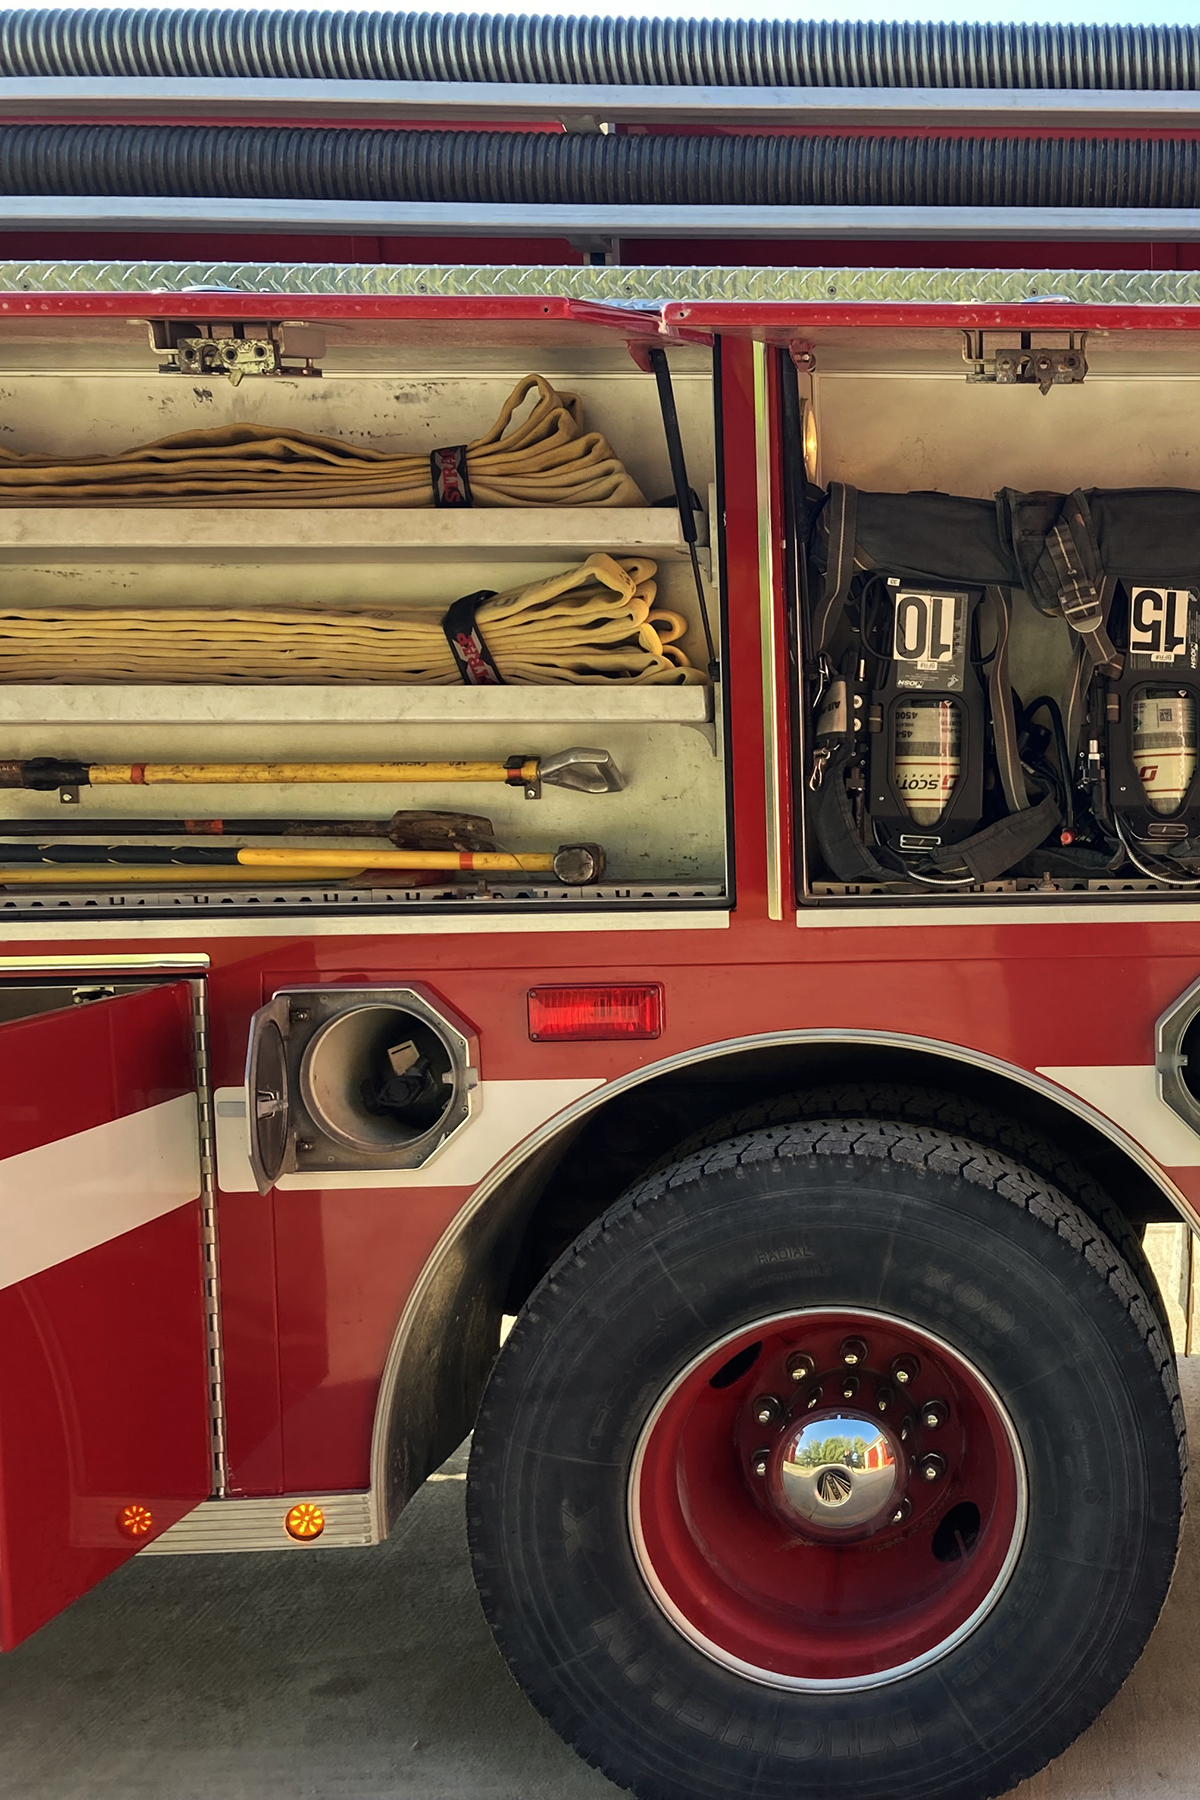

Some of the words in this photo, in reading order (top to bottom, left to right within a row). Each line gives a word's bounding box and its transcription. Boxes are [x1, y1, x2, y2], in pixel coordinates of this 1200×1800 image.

[895, 596, 951, 660] 10
[1131, 590, 1184, 652] 15
[1190, 641, 1199, 669] NIOSH
[897, 679, 925, 688] NIOSH
[895, 711, 918, 719] 4500
[757, 1246, 813, 1264] RADIAL
